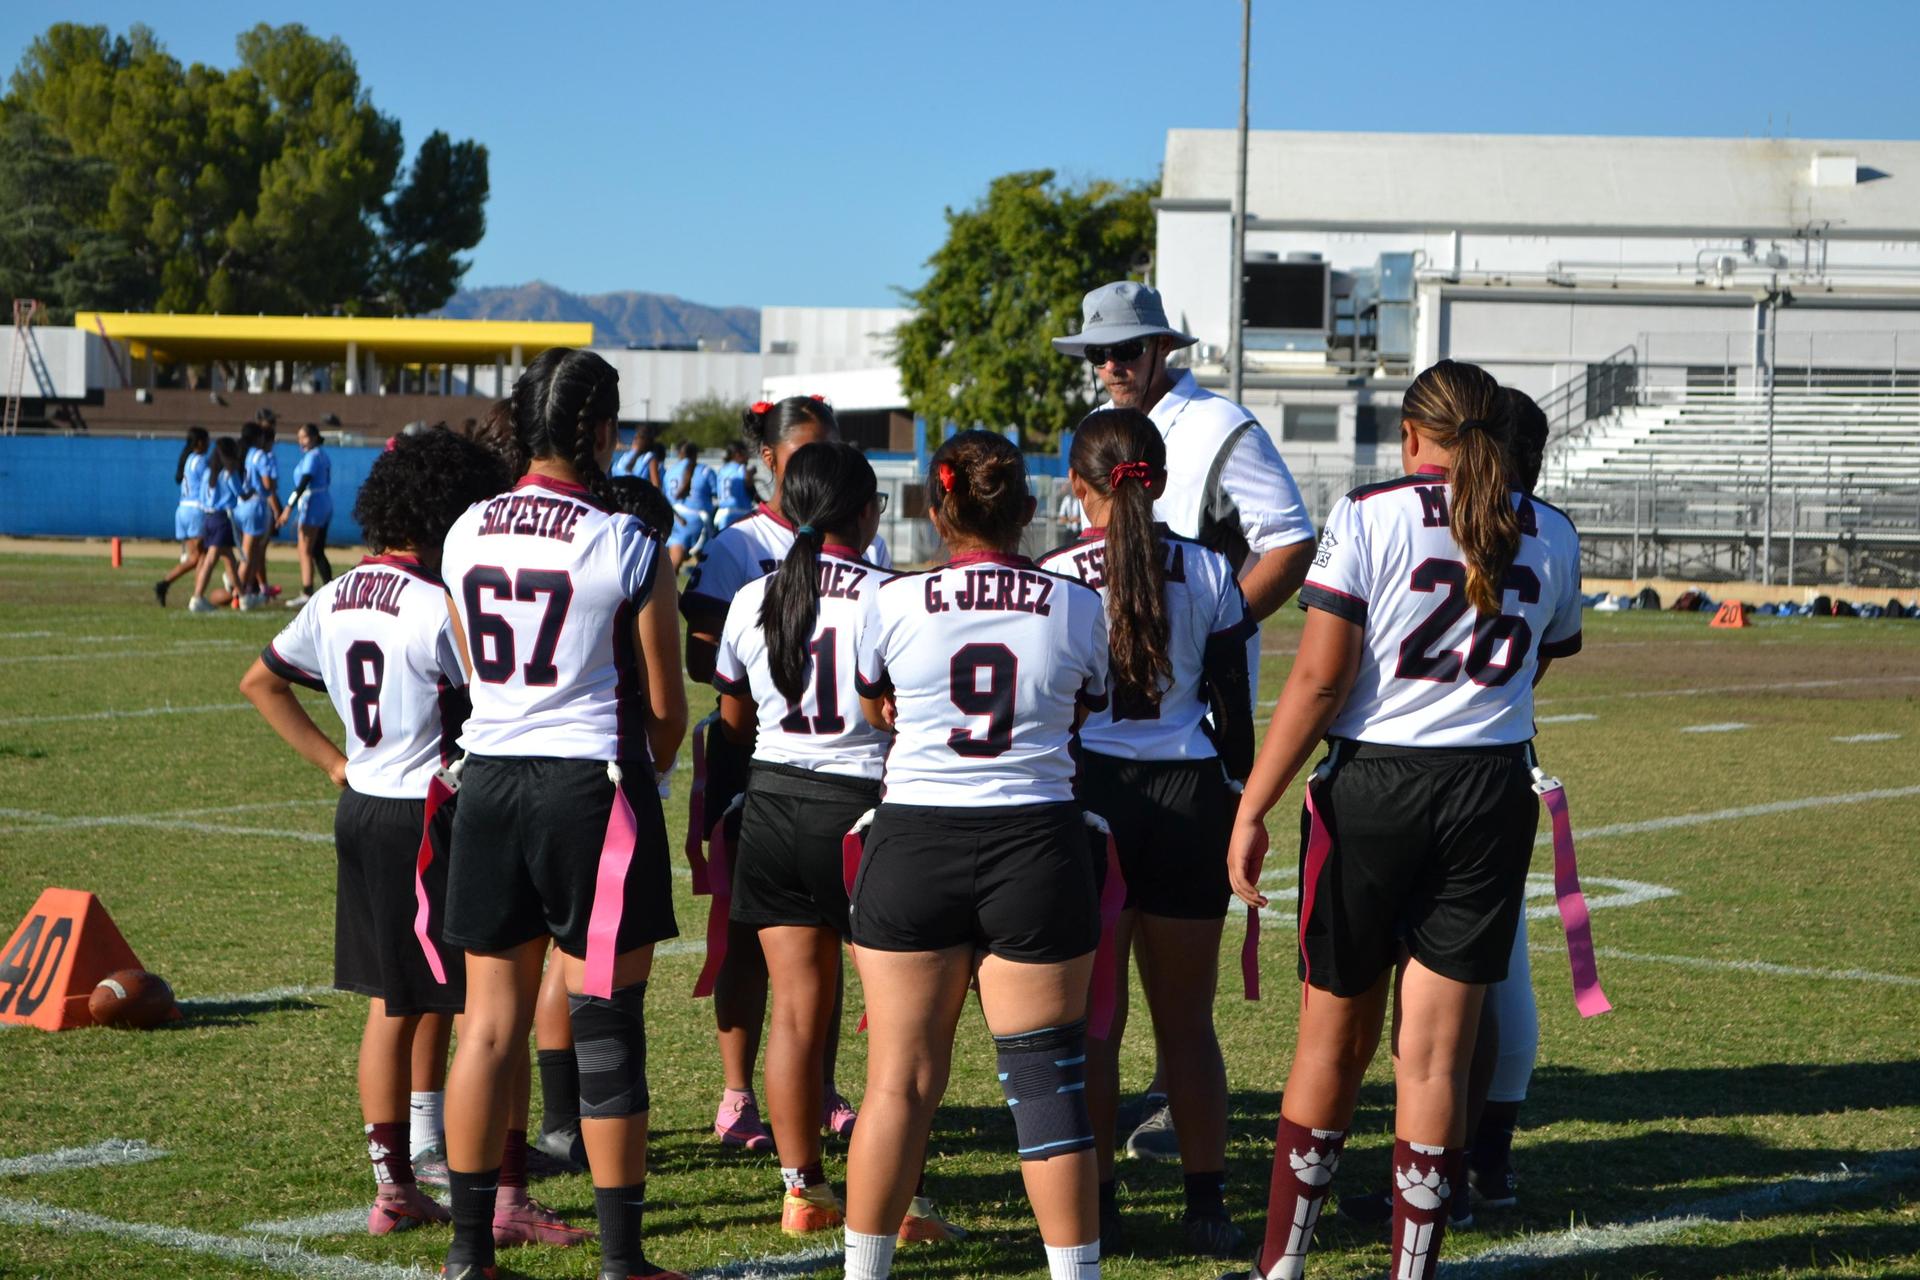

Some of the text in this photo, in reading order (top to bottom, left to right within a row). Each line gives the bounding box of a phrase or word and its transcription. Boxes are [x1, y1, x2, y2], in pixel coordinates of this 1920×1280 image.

[478, 495, 589, 543] SILVESTRE
[332, 571, 410, 617] SANDOVAL
[462, 564, 574, 687] 67
[924, 569, 1054, 616] G. JEREZ
[1394, 557, 1541, 687] 26
[1720, 604, 1739, 624] 20
[345, 640, 385, 748] 8
[947, 643, 1018, 758] 9
[0, 915, 73, 1017] 40
